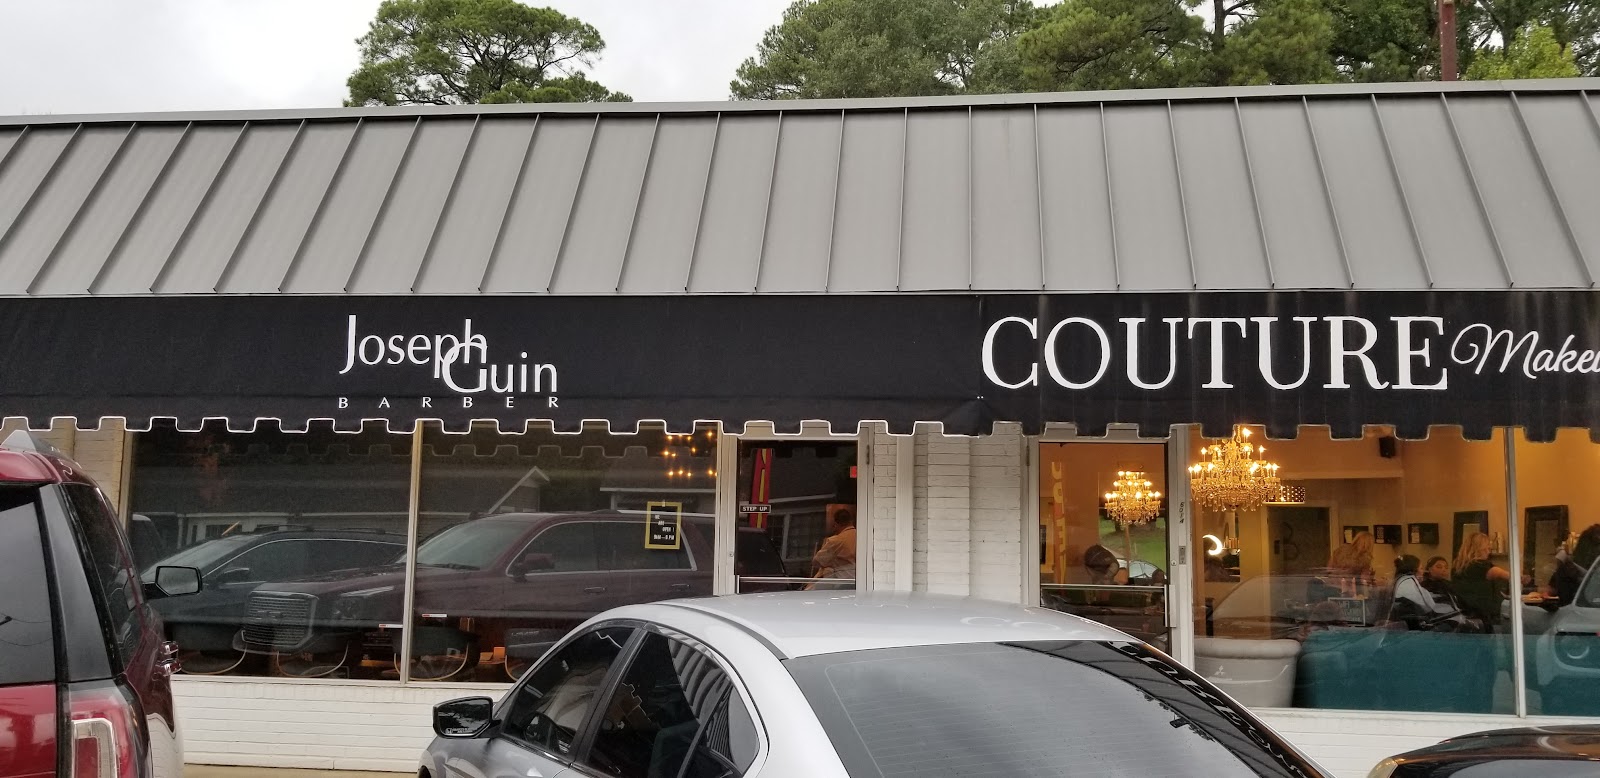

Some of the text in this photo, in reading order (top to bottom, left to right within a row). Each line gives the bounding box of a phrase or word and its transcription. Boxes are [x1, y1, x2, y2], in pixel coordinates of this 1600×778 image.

[339, 314, 487, 379] Joseph
[442, 341, 558, 393] Guin
[981, 316, 1447, 390] COUTURE
[338, 397, 559, 408] BARBER
